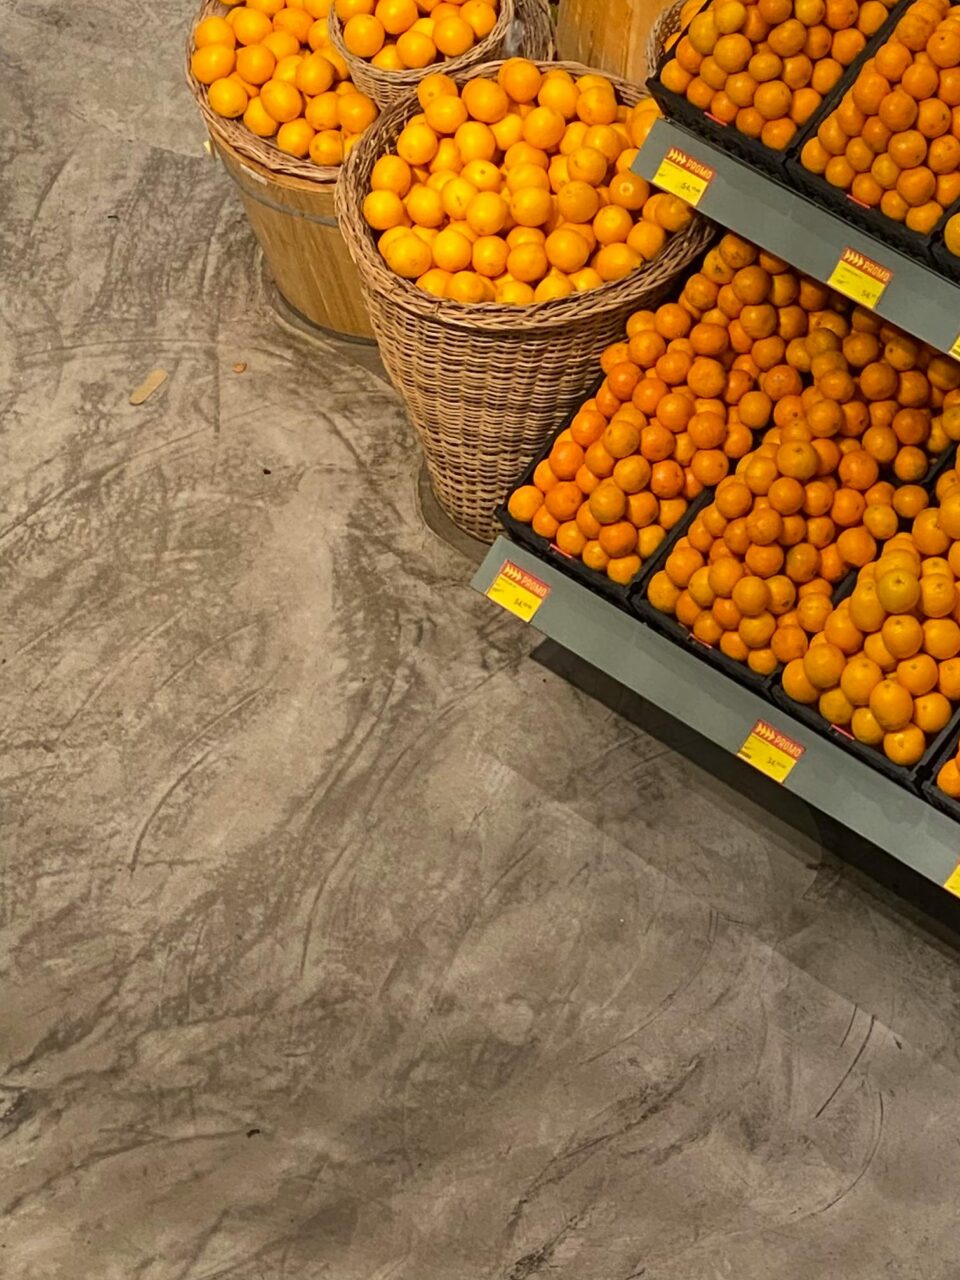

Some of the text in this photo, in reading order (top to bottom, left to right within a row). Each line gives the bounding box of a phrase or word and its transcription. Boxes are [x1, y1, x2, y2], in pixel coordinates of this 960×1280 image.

[685, 159, 713, 180] PROMO
[862, 261, 890, 282] PROMO
[520, 575, 548, 597] PROMO
[774, 735, 802, 757] PROMO
